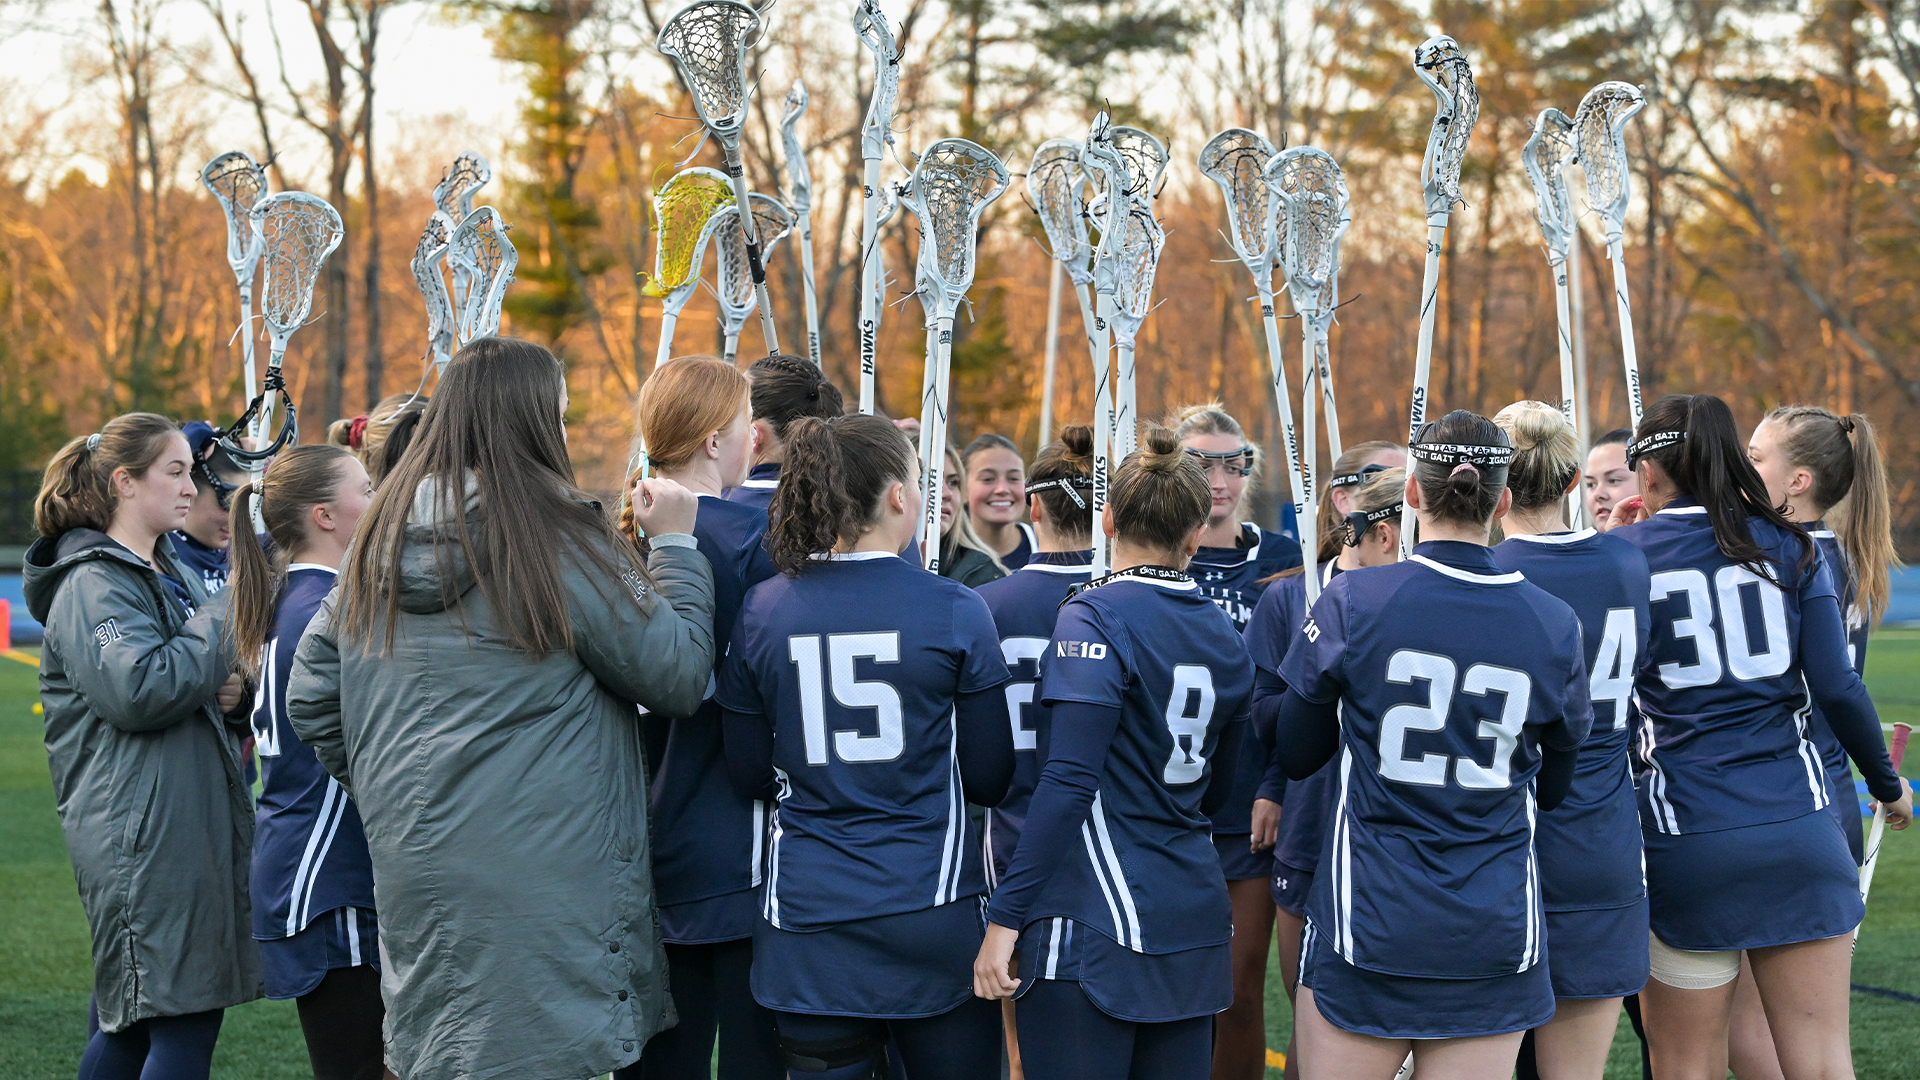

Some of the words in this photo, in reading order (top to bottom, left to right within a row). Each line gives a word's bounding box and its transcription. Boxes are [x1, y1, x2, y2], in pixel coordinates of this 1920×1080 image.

[862, 319, 874, 375] HAWKS
[1286, 423, 1301, 472] HAWKS
[1430, 452, 1454, 463] GAIT
[1638, 436, 1652, 449] GAIT
[1655, 431, 1680, 441] GAIT
[927, 468, 938, 525] HAWKS
[1095, 455, 1106, 513] HAWKS
[1347, 474, 1359, 483] GA
[1368, 508, 1390, 521] GAIT
[1083, 579, 1103, 592] AIT
[1107, 569, 1134, 582] GAIT
[1158, 570, 1178, 578] GAIT
[94, 618, 122, 649] 31
[1057, 640, 1107, 660] NE10
[1649, 561, 1793, 691] 30
[1588, 606, 1638, 731] 4
[788, 630, 906, 767] 15
[1163, 662, 1217, 786] 8
[1378, 647, 1532, 791] 23
